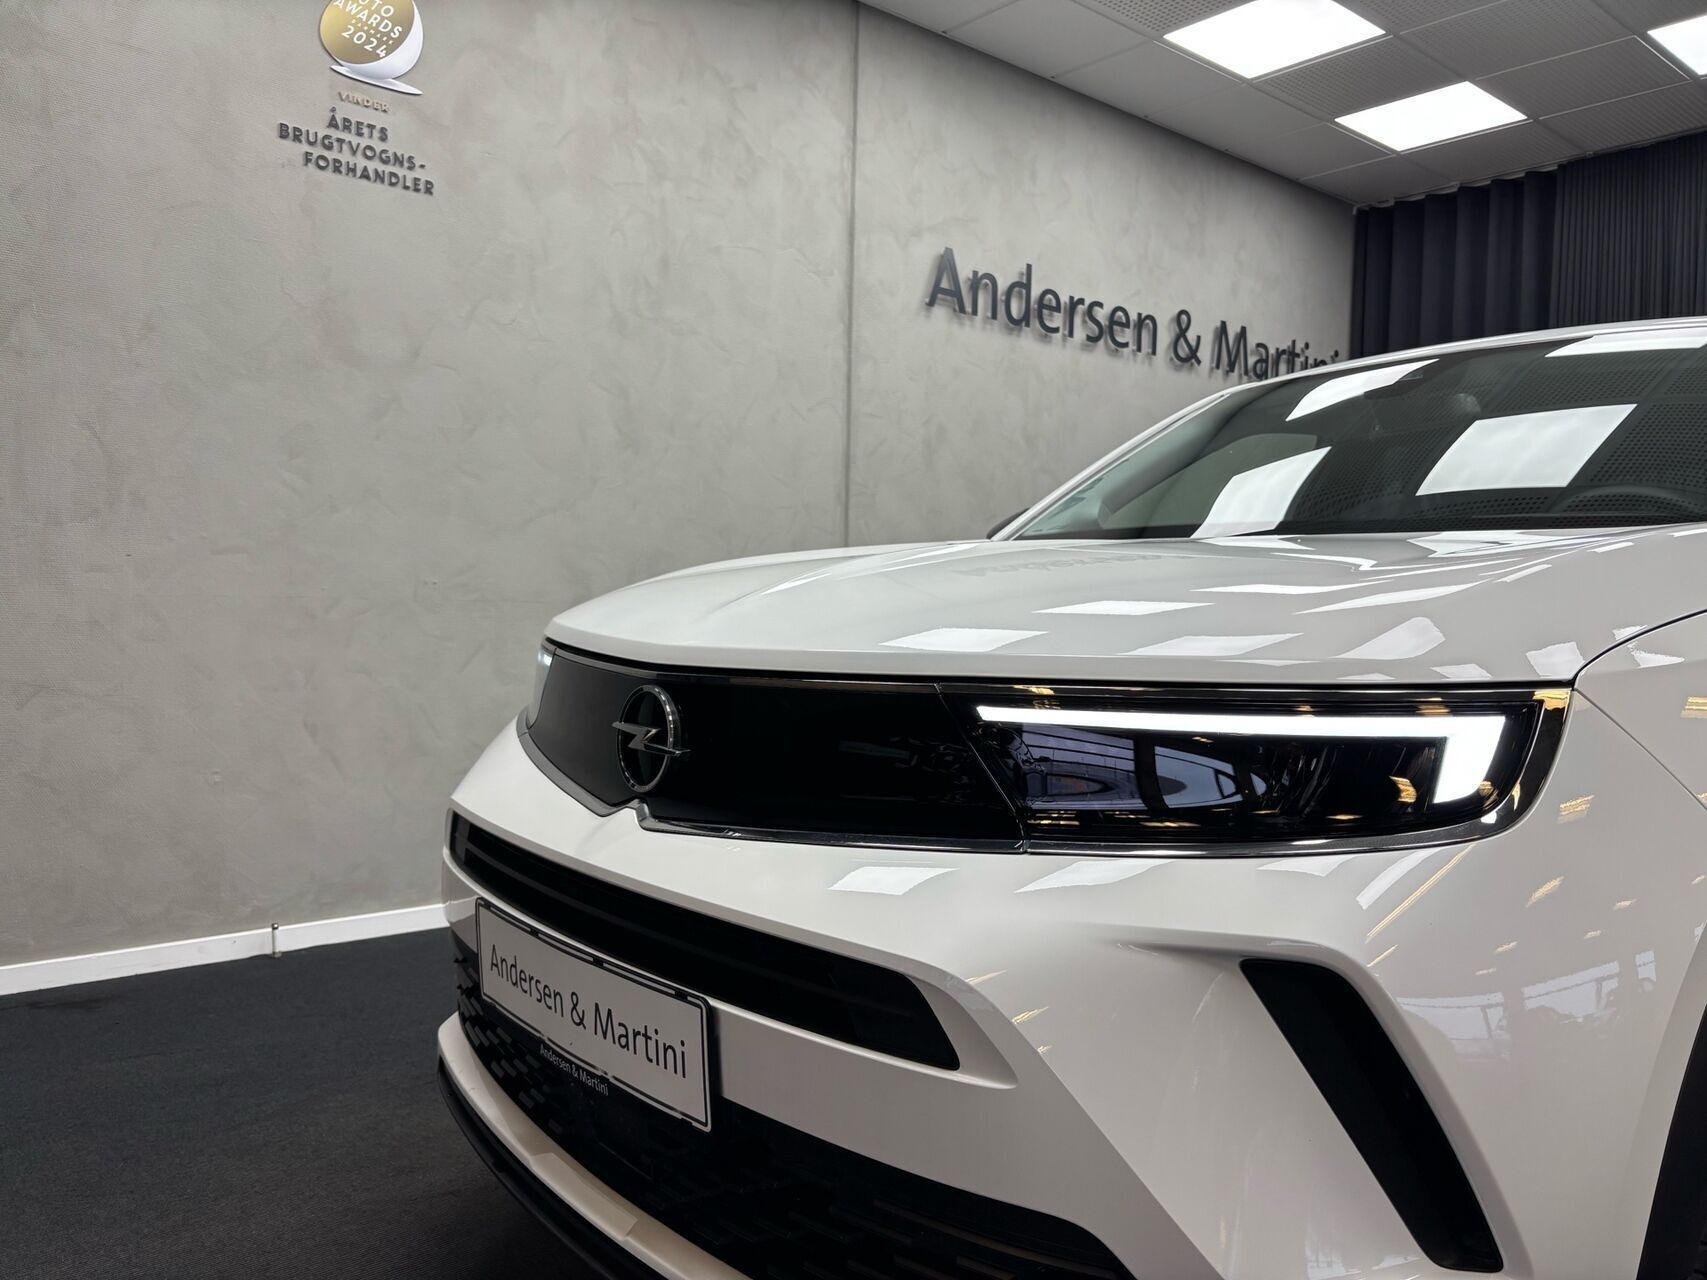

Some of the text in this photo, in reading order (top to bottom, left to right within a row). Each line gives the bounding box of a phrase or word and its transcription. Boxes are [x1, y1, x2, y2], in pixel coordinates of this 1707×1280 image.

[333, 0, 402, 38] AWARDS
[341, 25, 387, 58] 2024
[327, 106, 388, 142] ÅRETS
[338, 91, 391, 113] VINDER
[278, 122, 426, 171] BRUGTVOGNS-
[303, 151, 434, 195] FORHANDLER
[926, 246, 1340, 380] Andersen & Marti
[490, 944, 686, 1078] Andersen & Martini
[540, 1043, 608, 1096] Andersen & Martini
